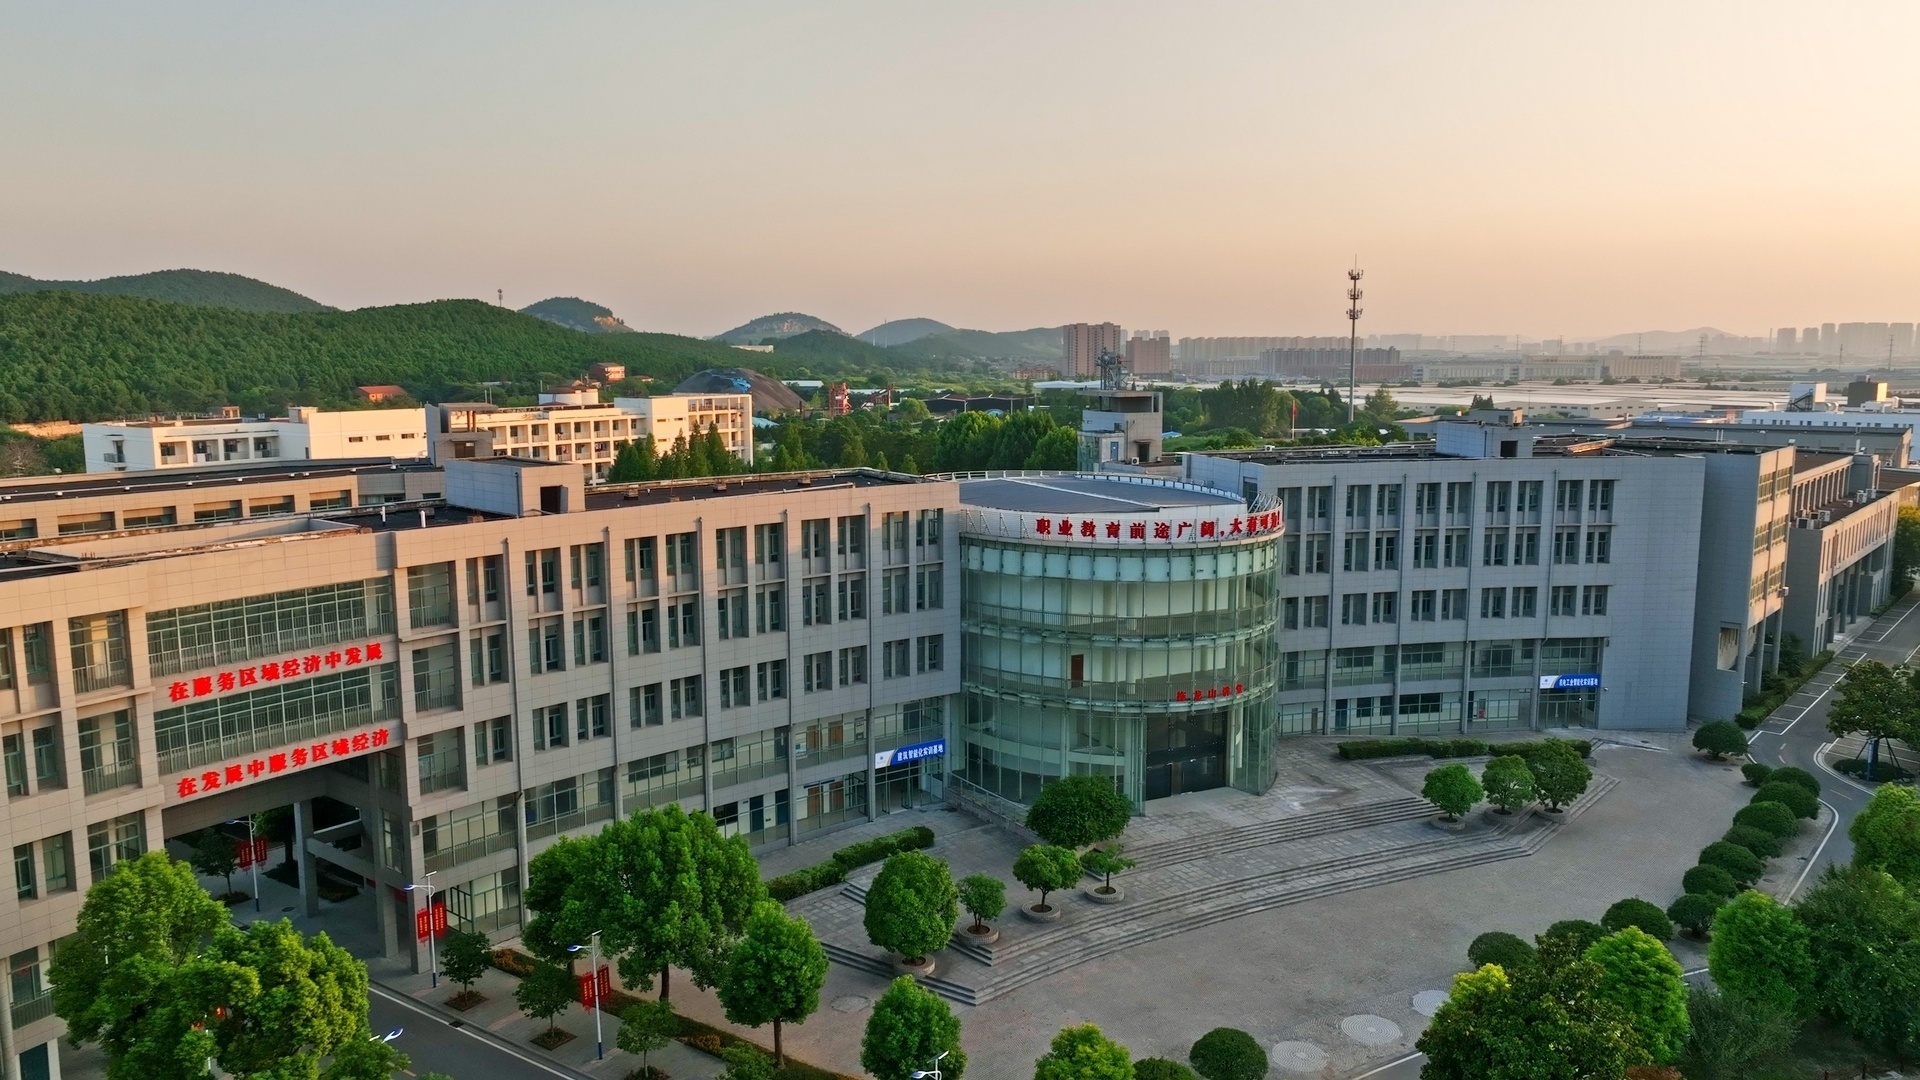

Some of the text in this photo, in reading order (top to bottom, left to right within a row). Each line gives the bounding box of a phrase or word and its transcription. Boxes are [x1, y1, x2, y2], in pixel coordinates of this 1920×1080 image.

[168, 642, 384, 703] 在服务区域经济中发展
[177, 728, 390, 799] 在发展中服务区域经济
[897, 744, 944, 762] 建筑智能化实训基地
